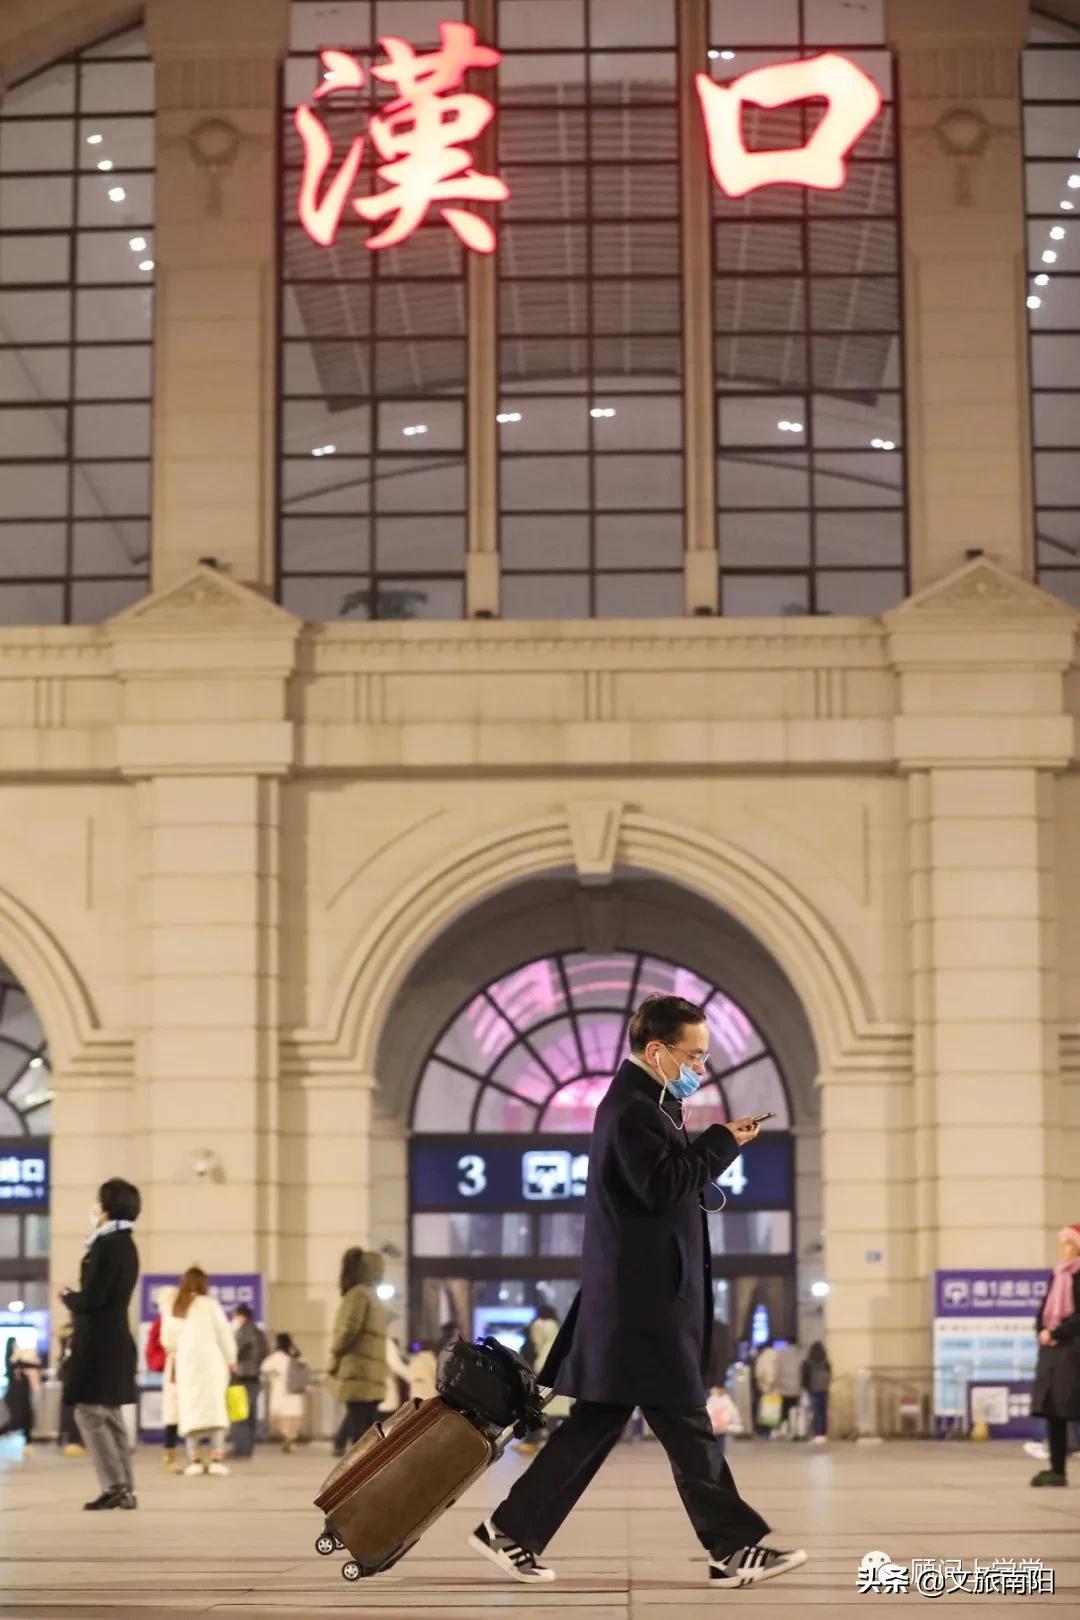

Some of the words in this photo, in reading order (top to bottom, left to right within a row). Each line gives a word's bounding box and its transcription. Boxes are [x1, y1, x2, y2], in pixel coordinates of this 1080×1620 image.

[293, 20, 882, 254] 漢口
[457, 1155, 487, 1196] 3
[716, 1153, 748, 1195] 4
